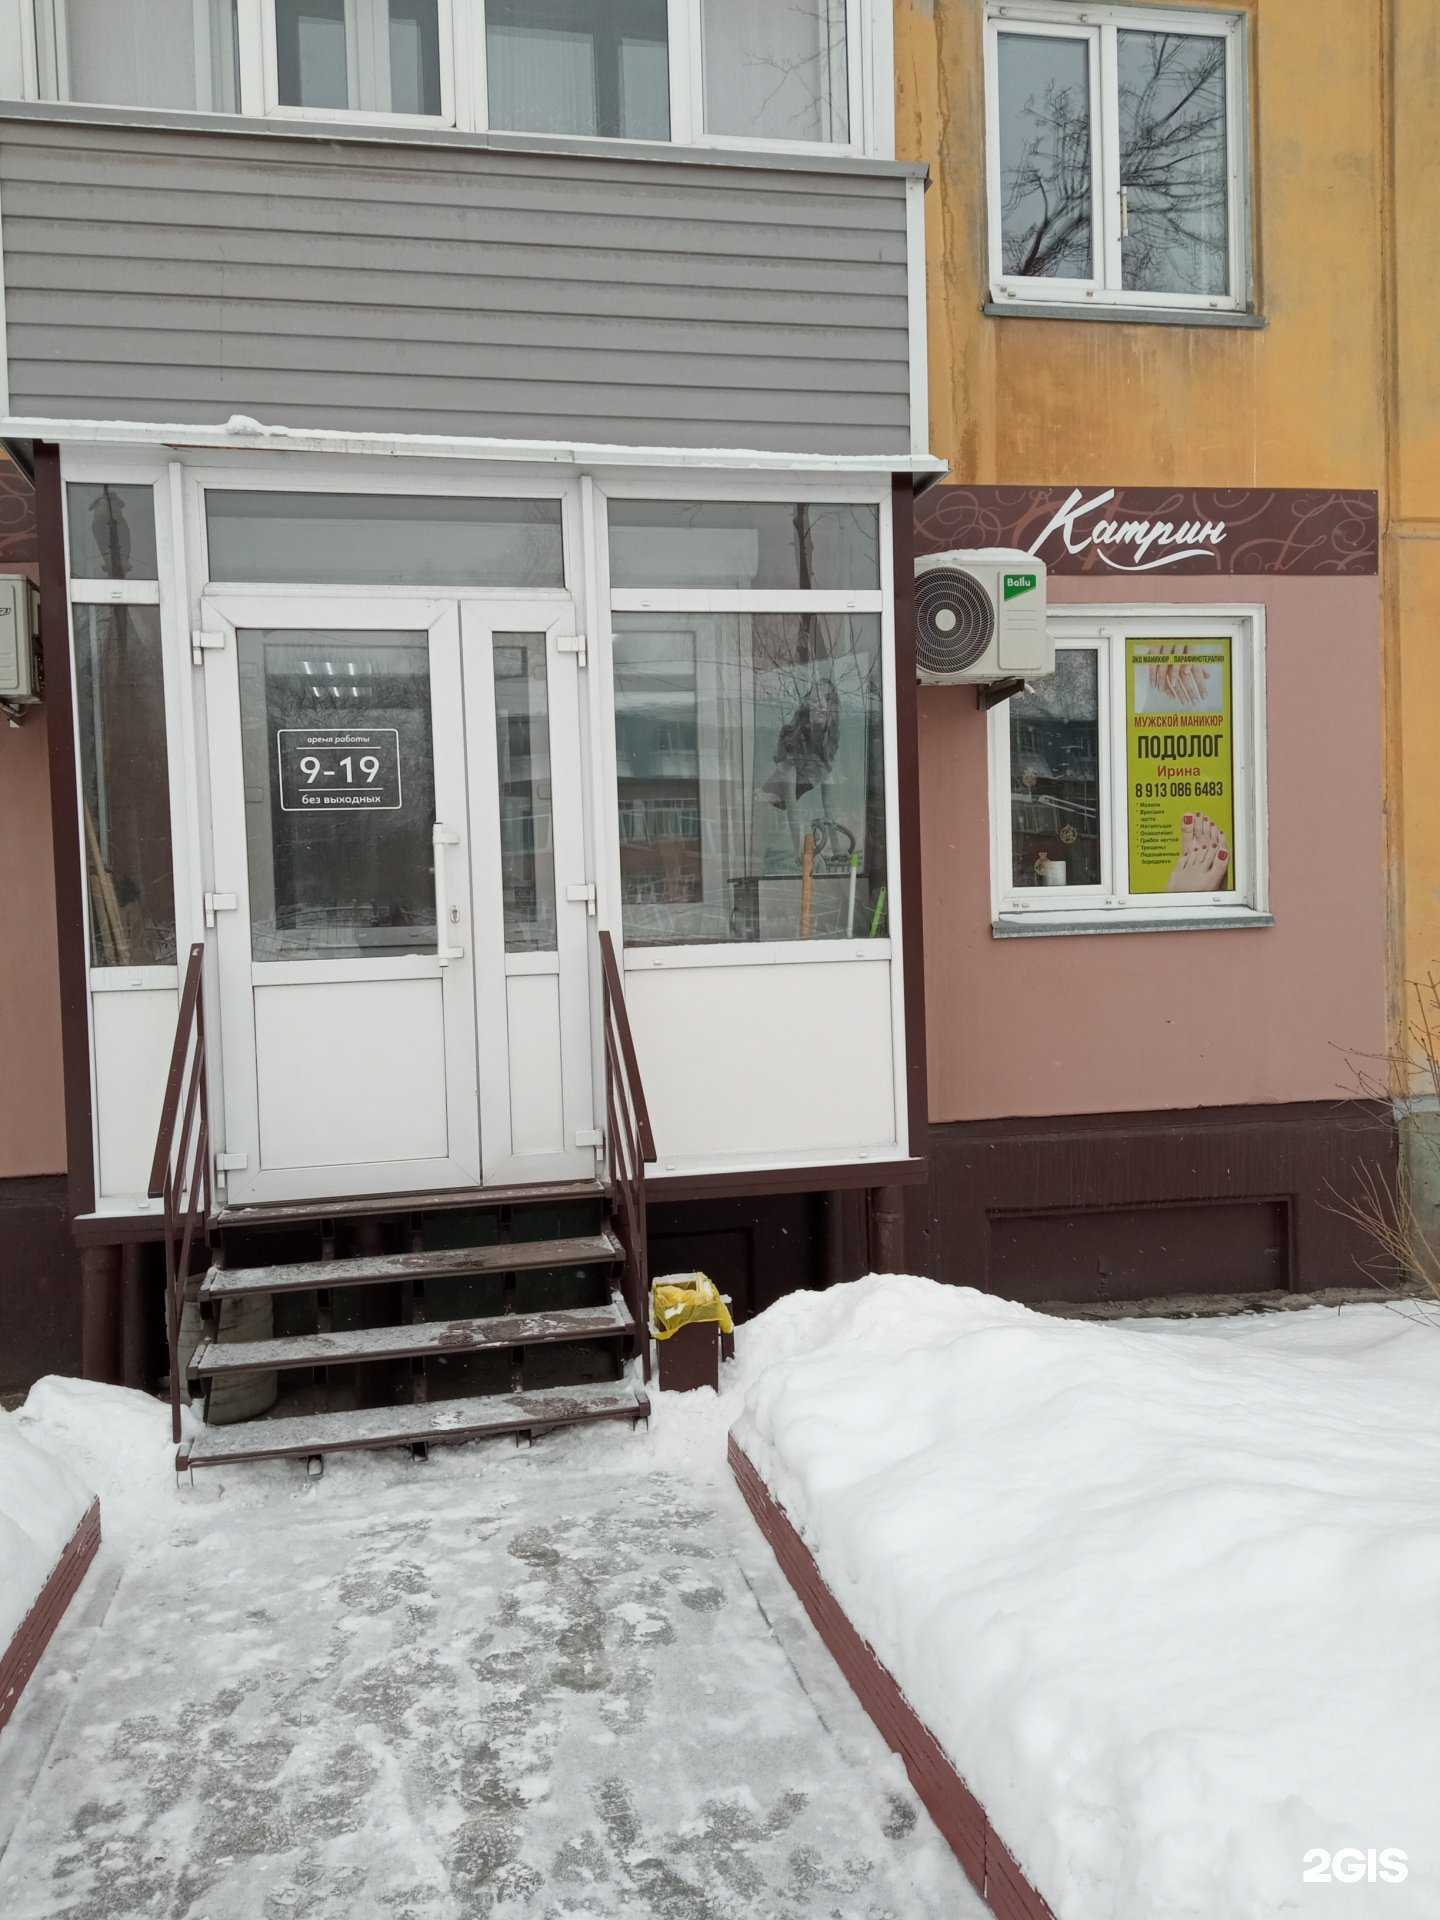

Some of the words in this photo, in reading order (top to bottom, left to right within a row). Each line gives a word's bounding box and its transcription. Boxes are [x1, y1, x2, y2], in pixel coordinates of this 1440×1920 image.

[1027, 488, 1226, 566] Катрин
[1007, 577, 1031, 587] Ballu
[1134, 714, 1179, 728] МУЖСКОЙ
[1180, 715, 1224, 727] МАНИКЮР
[335, 734, 370, 744] работы
[1138, 734, 1223, 761] ПОДОЛОГ
[300, 756, 380, 784] 9-19
[1157, 765, 1201, 779] Ирина
[1135, 783, 1143, 797] 8
[1145, 783, 1168, 797] 913
[1170, 783, 1192, 797] 086
[1194, 782, 1223, 796] 6483
[302, 794, 321, 805] без
[324, 795, 381, 804] выходных
